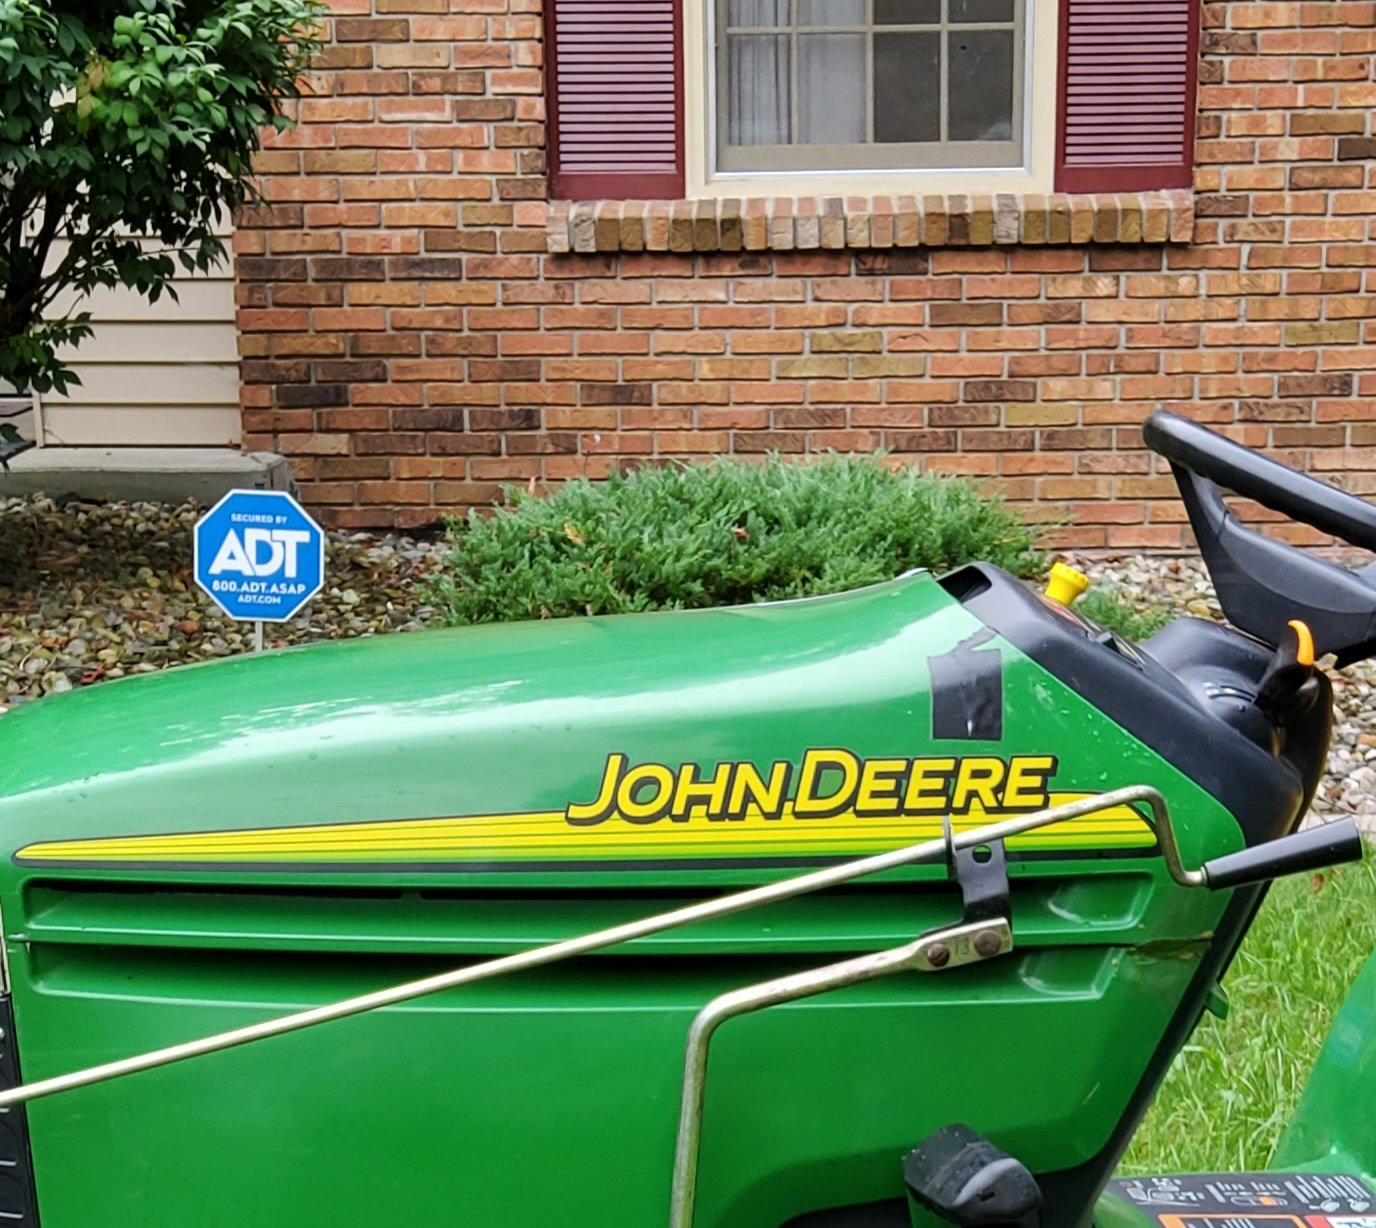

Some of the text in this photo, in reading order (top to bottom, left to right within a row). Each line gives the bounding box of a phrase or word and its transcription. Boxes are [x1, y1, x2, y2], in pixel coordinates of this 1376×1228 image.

[231, 513, 288, 524] SECURED BY
[208, 527, 310, 578] ADT
[212, 580, 306, 595] 800.ADT.ASAP
[237, 594, 281, 605] ADT.COM
[565, 748, 1059, 827] JOHN DEERE
